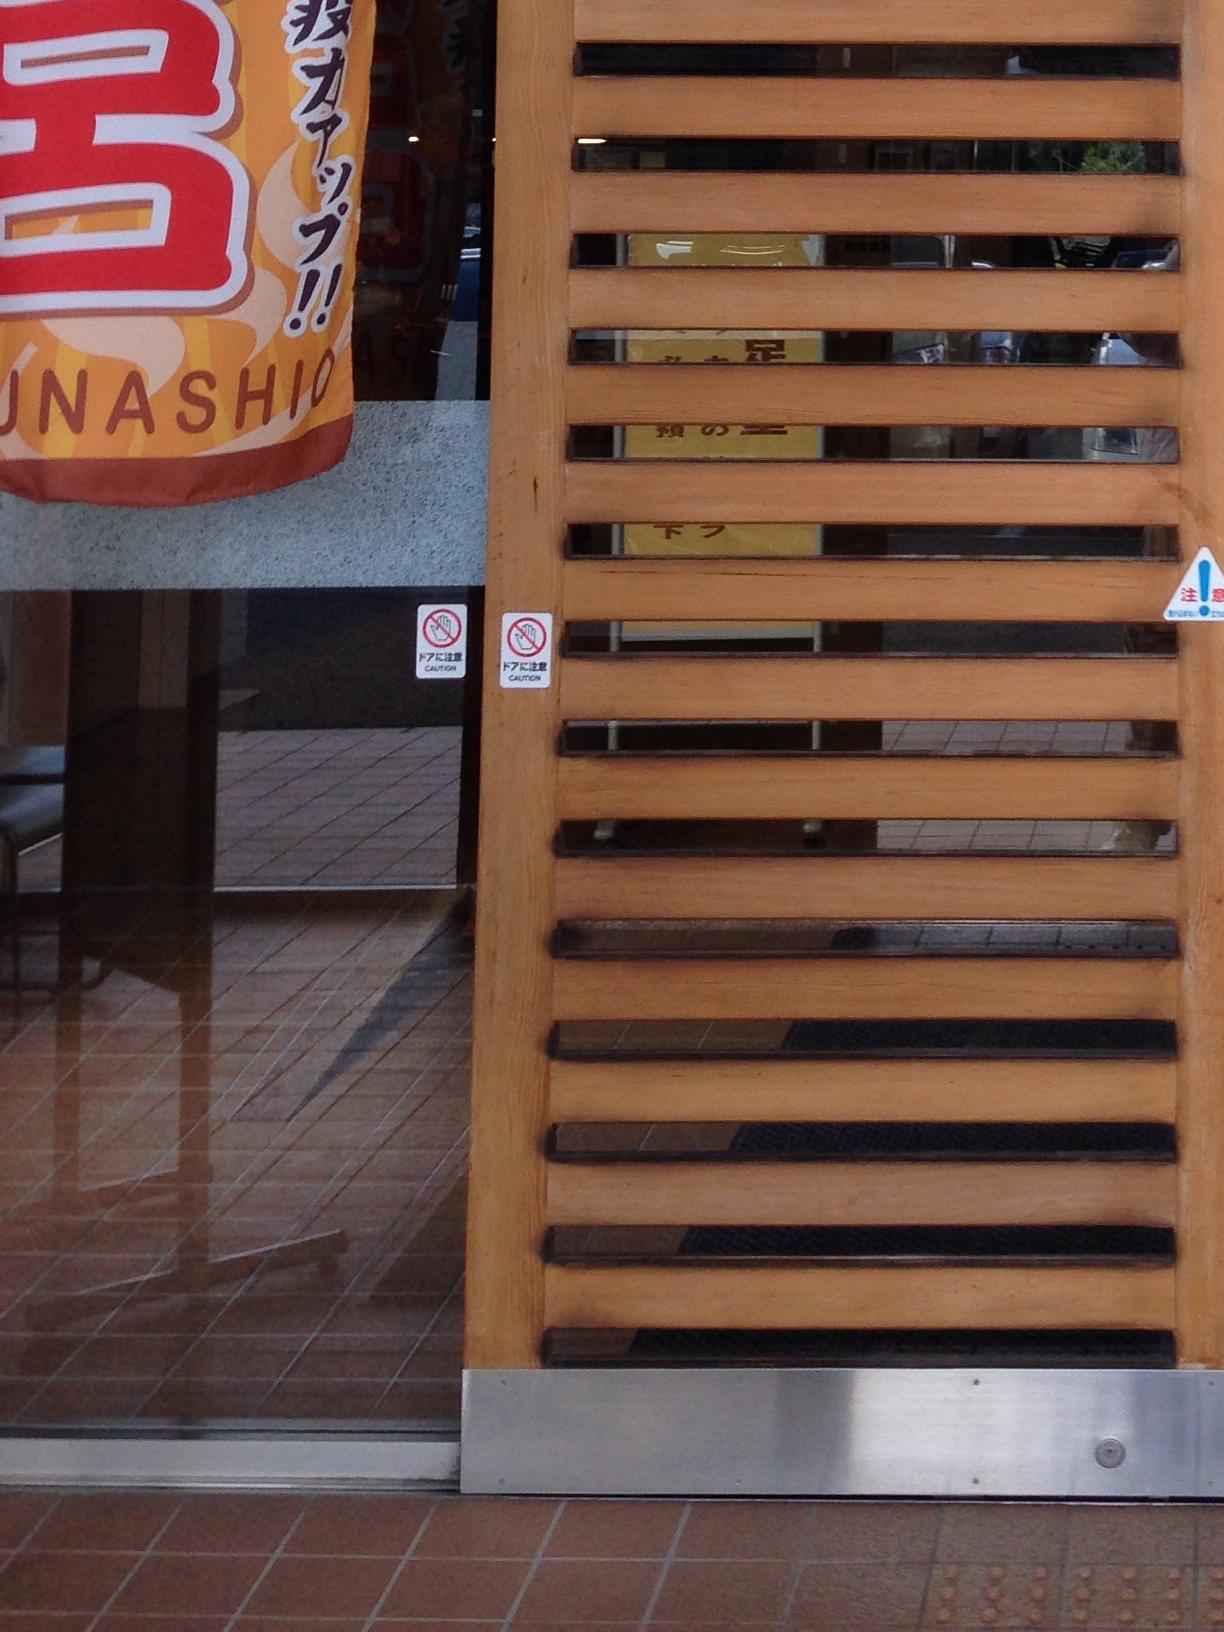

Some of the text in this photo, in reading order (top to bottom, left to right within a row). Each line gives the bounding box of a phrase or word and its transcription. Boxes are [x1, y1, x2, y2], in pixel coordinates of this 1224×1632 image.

[419, 652, 463, 662] ドアに注意
[503, 661, 547, 672] ドアに注意
[509, 674, 541, 682] CAUTION
